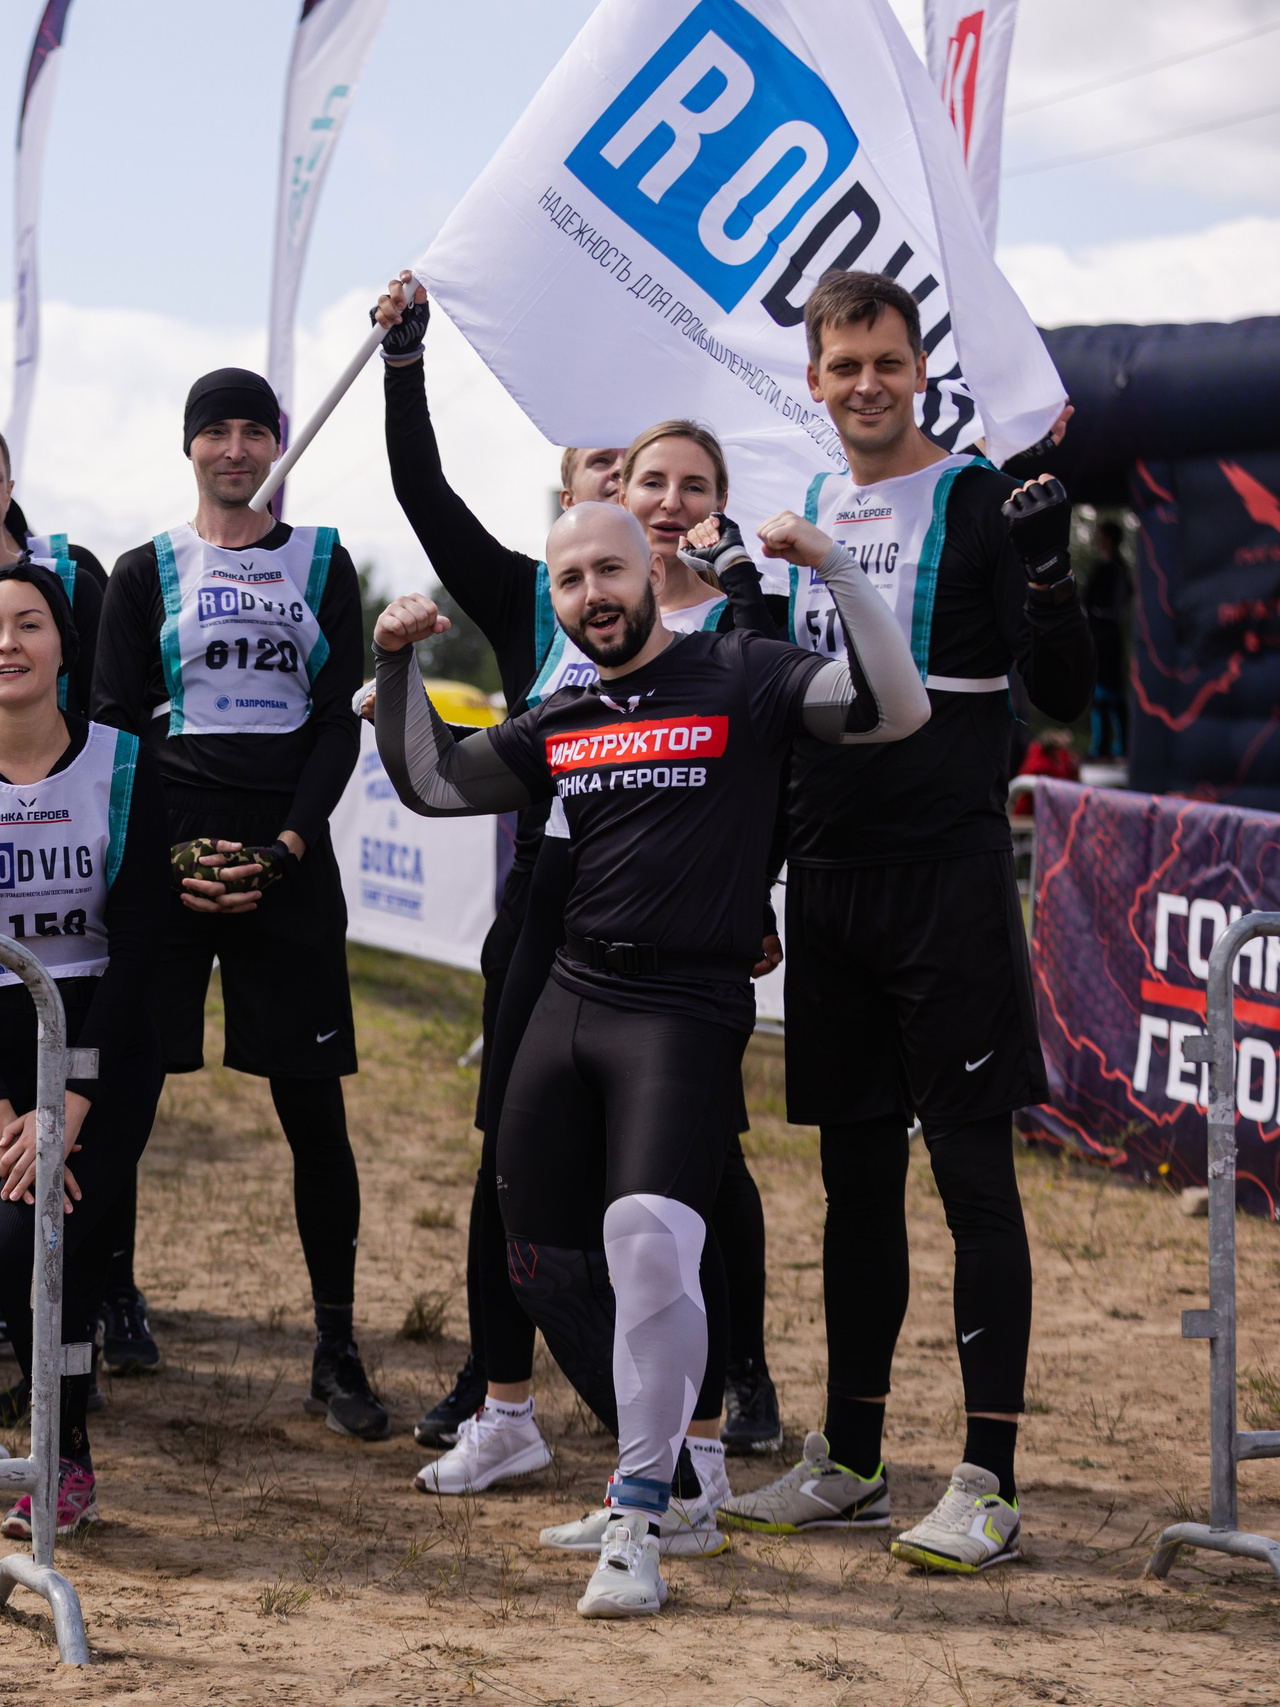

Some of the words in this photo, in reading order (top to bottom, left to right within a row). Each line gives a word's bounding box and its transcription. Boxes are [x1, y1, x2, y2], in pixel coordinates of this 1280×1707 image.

[537, 185, 631, 283] НАДЕЖНОСТЬ
[626, 273, 673, 319] ДЛЯ
[836, 511, 857, 521] ОНКА
[858, 507, 893, 519] ГЕРОЕВ
[212, 569, 245, 582] ГОНКА
[247, 570, 283, 582] ГЕРОЕВ
[200, 590, 303, 623] RODVIG
[205, 637, 299, 673] 6120
[235, 698, 288, 710] ГАЗПРОМБАНК
[550, 726, 713, 768] ИНСТРУКТОР
[556, 772, 603, 800] ОНКА
[609, 766, 707, 791] ГЕРОЕВ
[27, 809, 70, 821] ГЕРОЕВ
